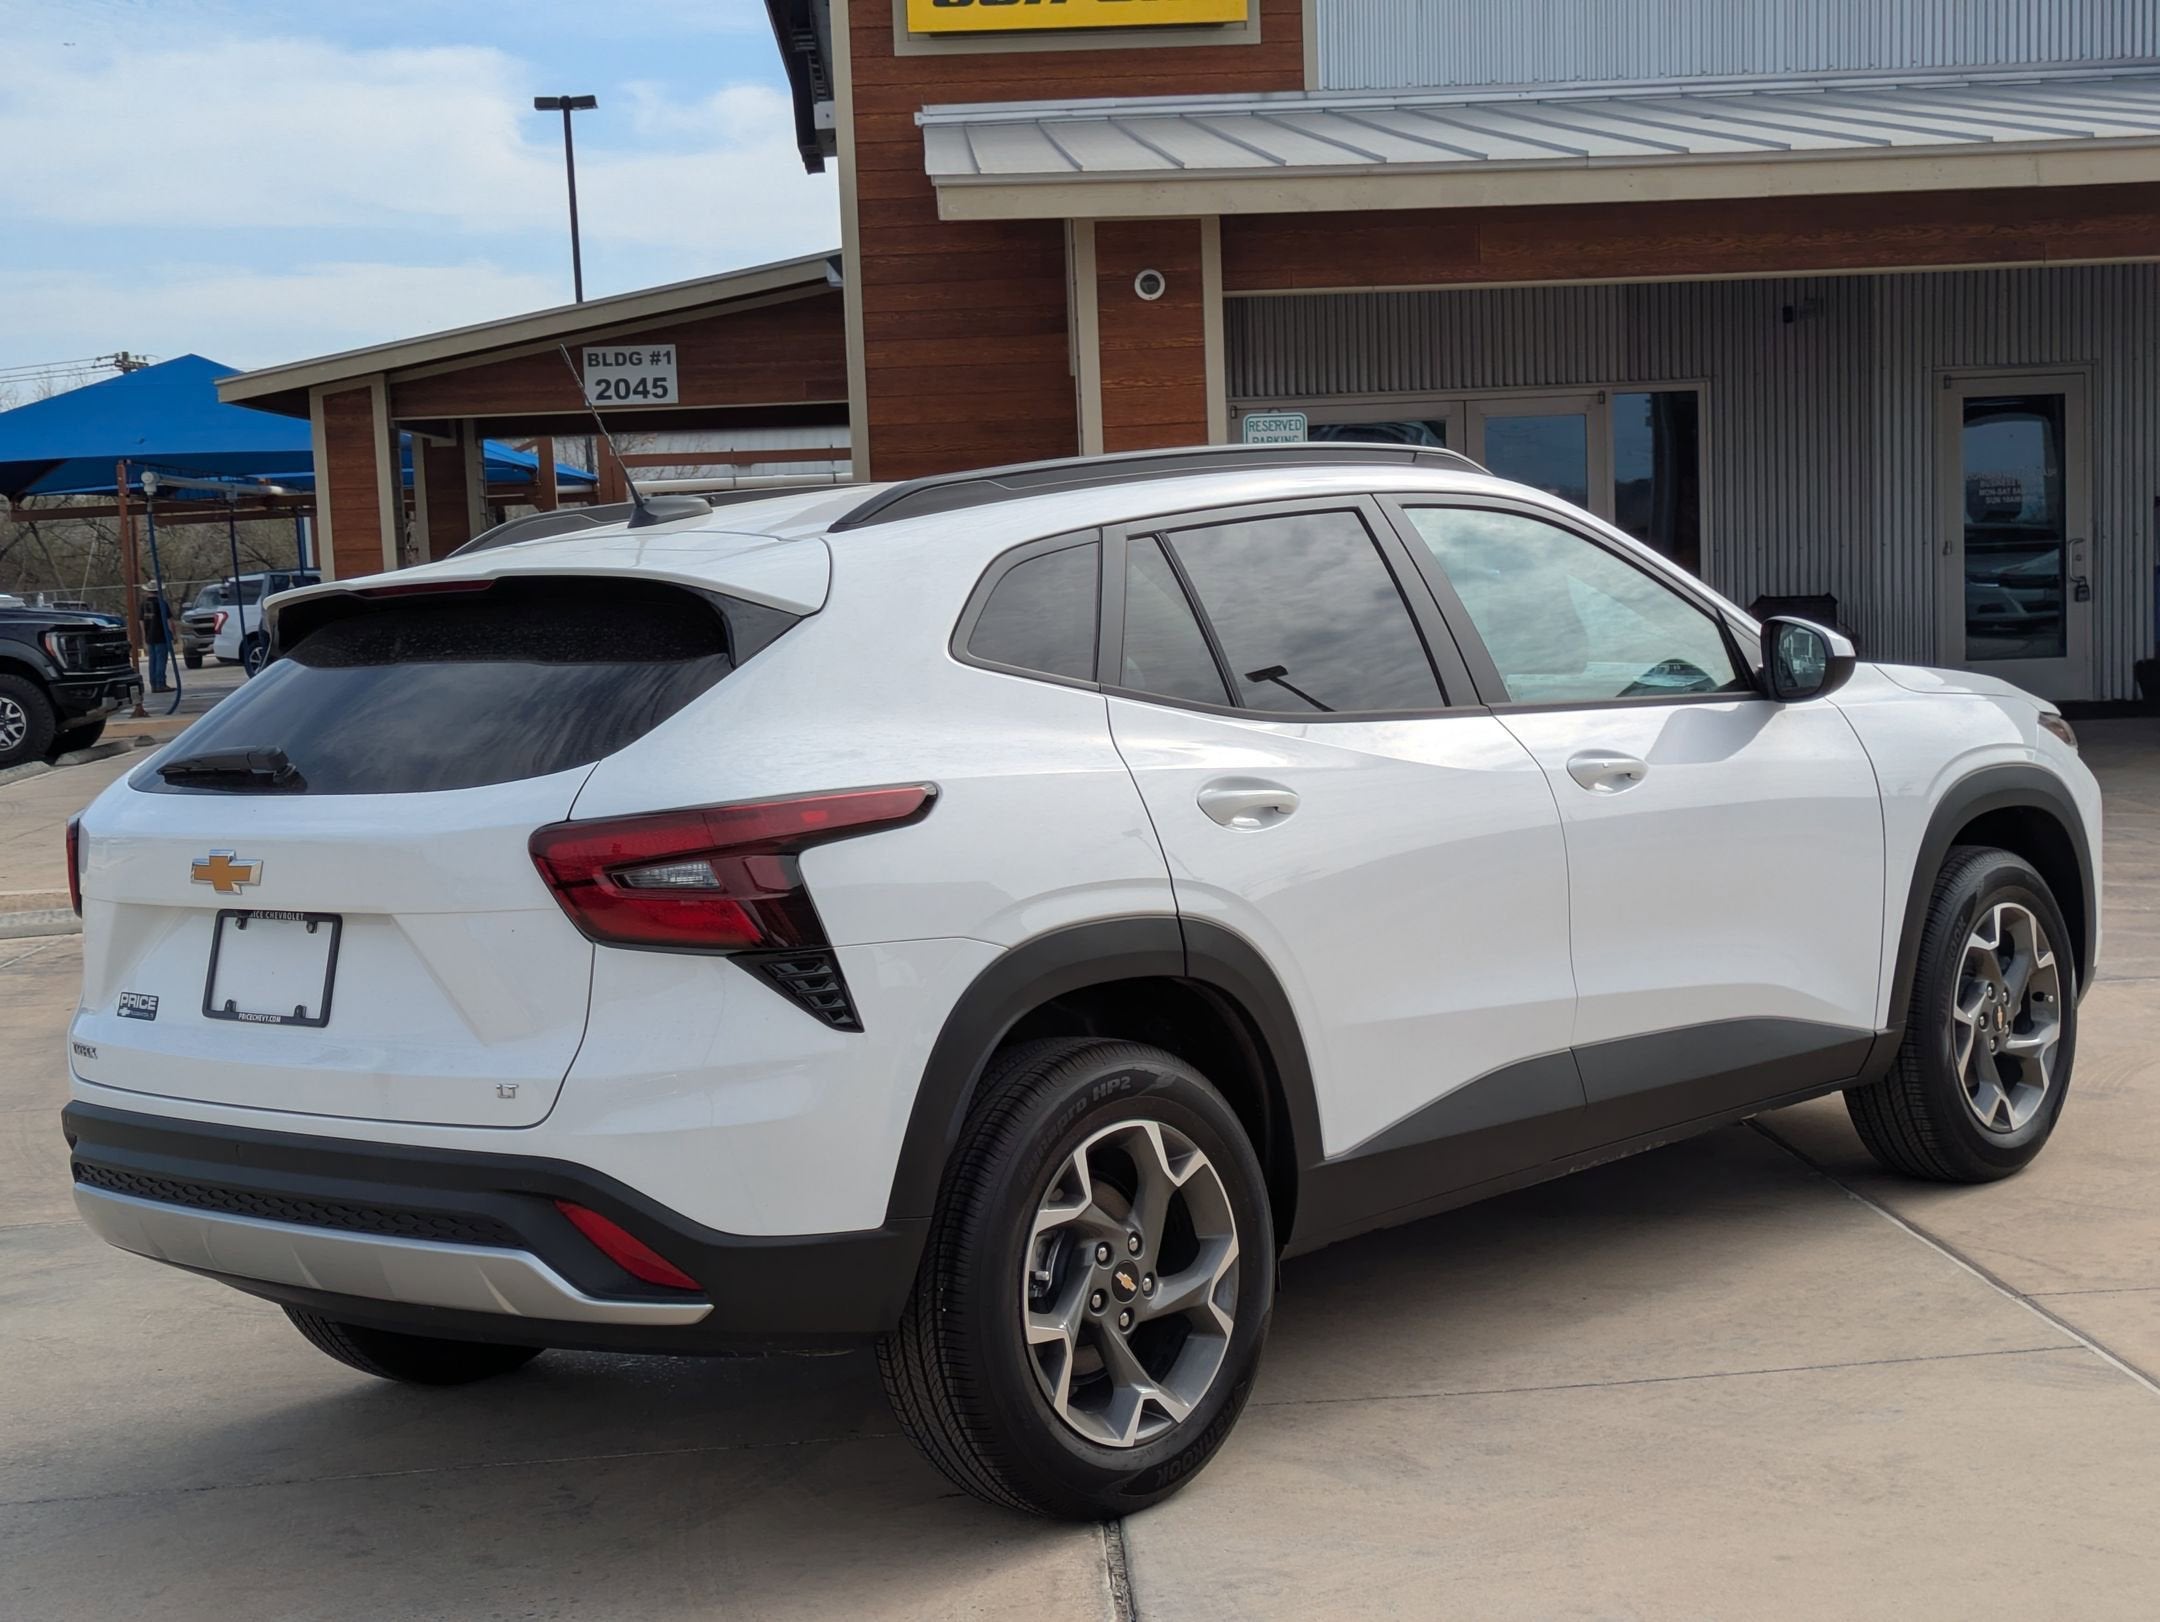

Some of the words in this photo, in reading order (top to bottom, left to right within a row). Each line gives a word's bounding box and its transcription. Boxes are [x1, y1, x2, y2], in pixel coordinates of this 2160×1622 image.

[587, 351, 643, 368] BLDG
[649, 350, 672, 366] #1
[595, 377, 669, 401] 2045
[1248, 419, 1302, 433] RESERVED
[265, 911, 305, 921] CHEVROLET
[120, 993, 158, 1011] PRICE
[496, 1083, 519, 1099] LT
[1091, 1074, 1131, 1102] HP2
